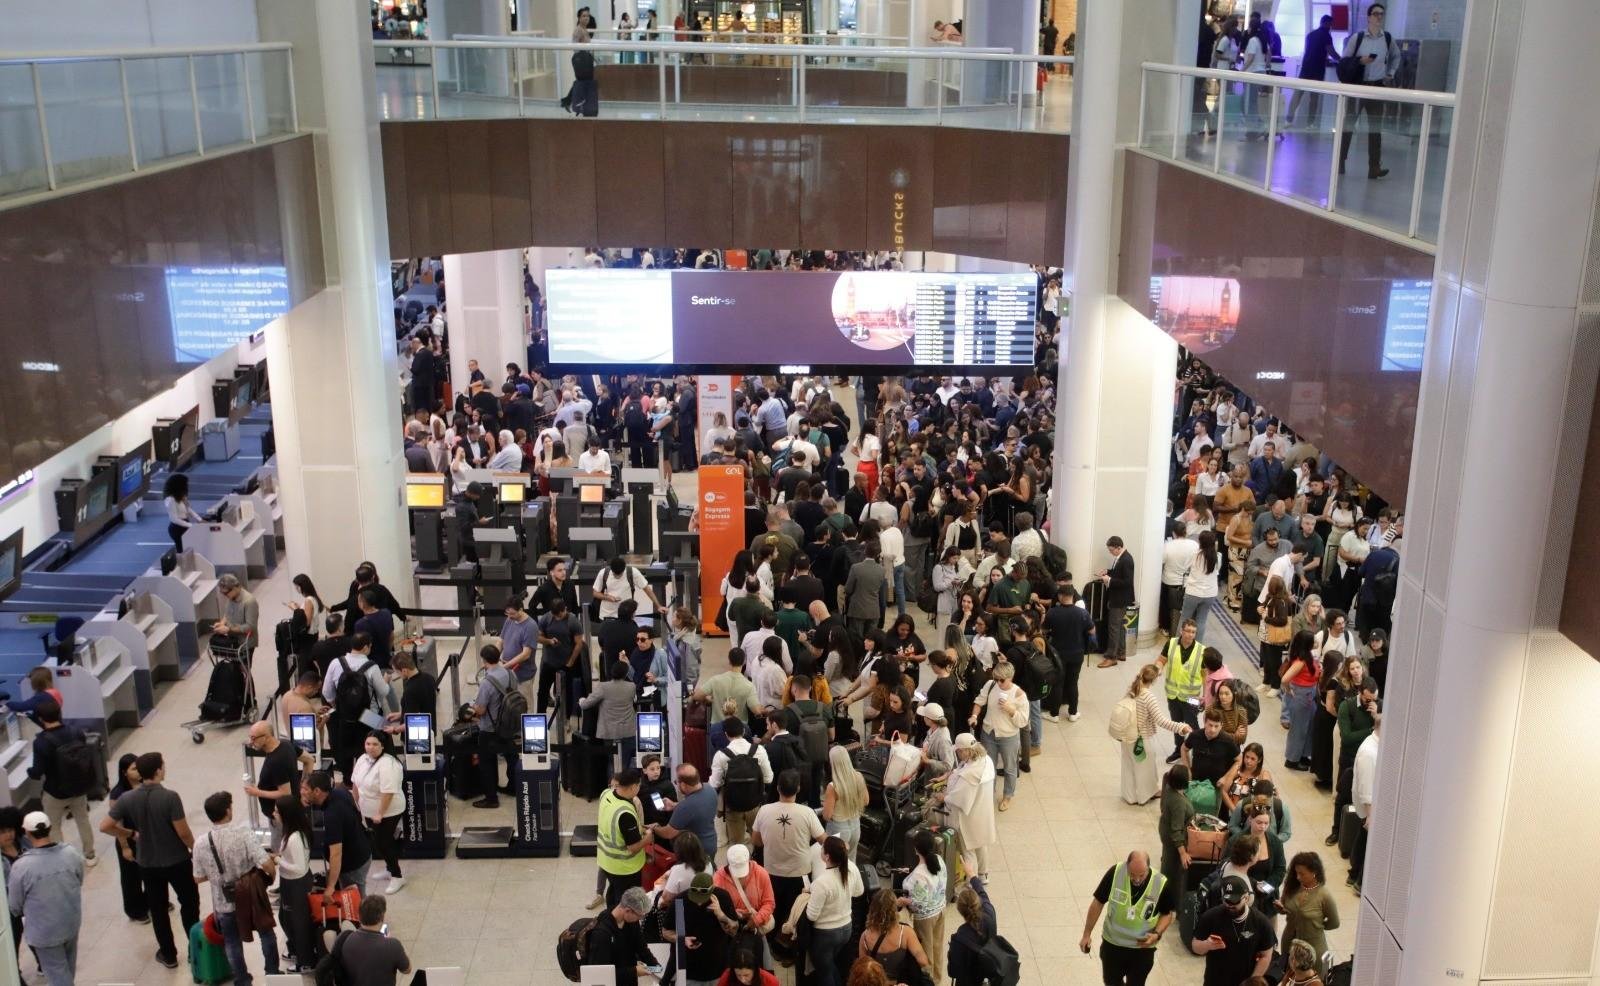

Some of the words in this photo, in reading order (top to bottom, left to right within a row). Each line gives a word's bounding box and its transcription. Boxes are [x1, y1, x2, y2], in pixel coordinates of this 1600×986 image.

[691, 295, 736, 305] Sentir-se
[171, 438, 179, 454] 13
[142, 459, 151, 475] 12
[725, 467, 742, 475] GOL
[77, 504, 87, 523] 11
[523, 815, 531, 842] Check-in
